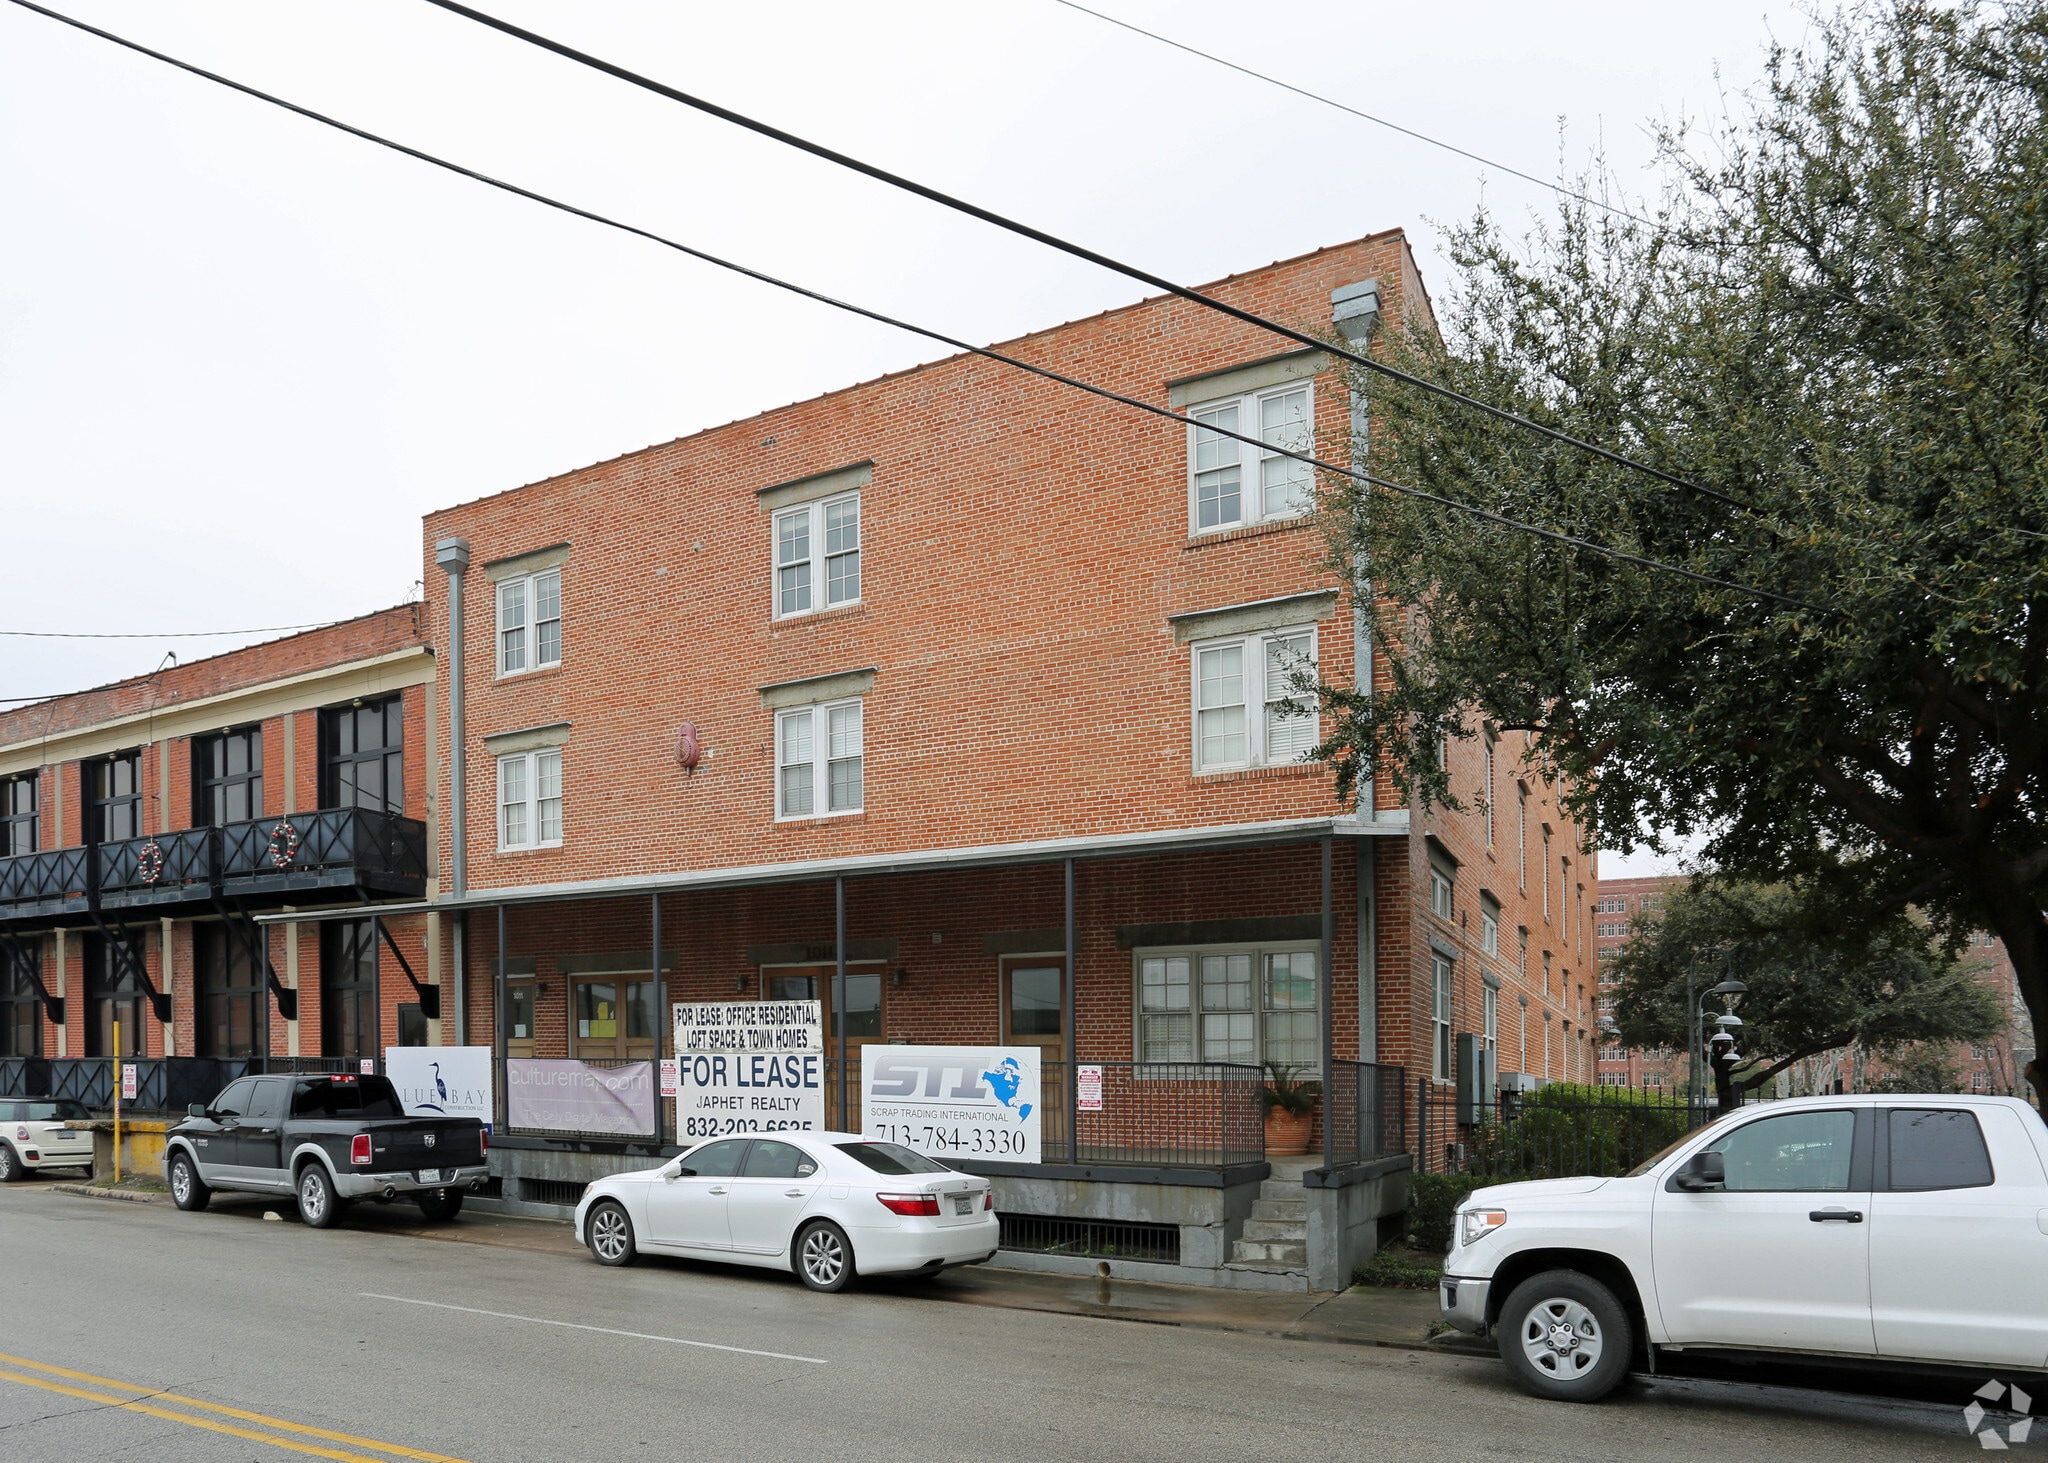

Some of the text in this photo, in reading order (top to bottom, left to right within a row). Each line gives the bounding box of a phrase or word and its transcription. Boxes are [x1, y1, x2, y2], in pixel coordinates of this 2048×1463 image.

[677, 1005, 817, 1027] FOR LEASE: OFFICE RESIDENTIAL
[687, 1028, 808, 1049] LOFT SPACE & TOWN HOMES
[510, 1066, 649, 1092] culturemapcom
[680, 1055, 819, 1089] FOR LEASE
[871, 1055, 992, 1099] STI
[403, 1088, 486, 1105] LUE BAY
[696, 1095, 801, 1112] JAPHET REALTY
[565, 1111, 591, 1125] Digital
[871, 1107, 1009, 1122] SCRAP TRADING INTERNATIONAL
[875, 1123, 1026, 1155] 713-784-3330
